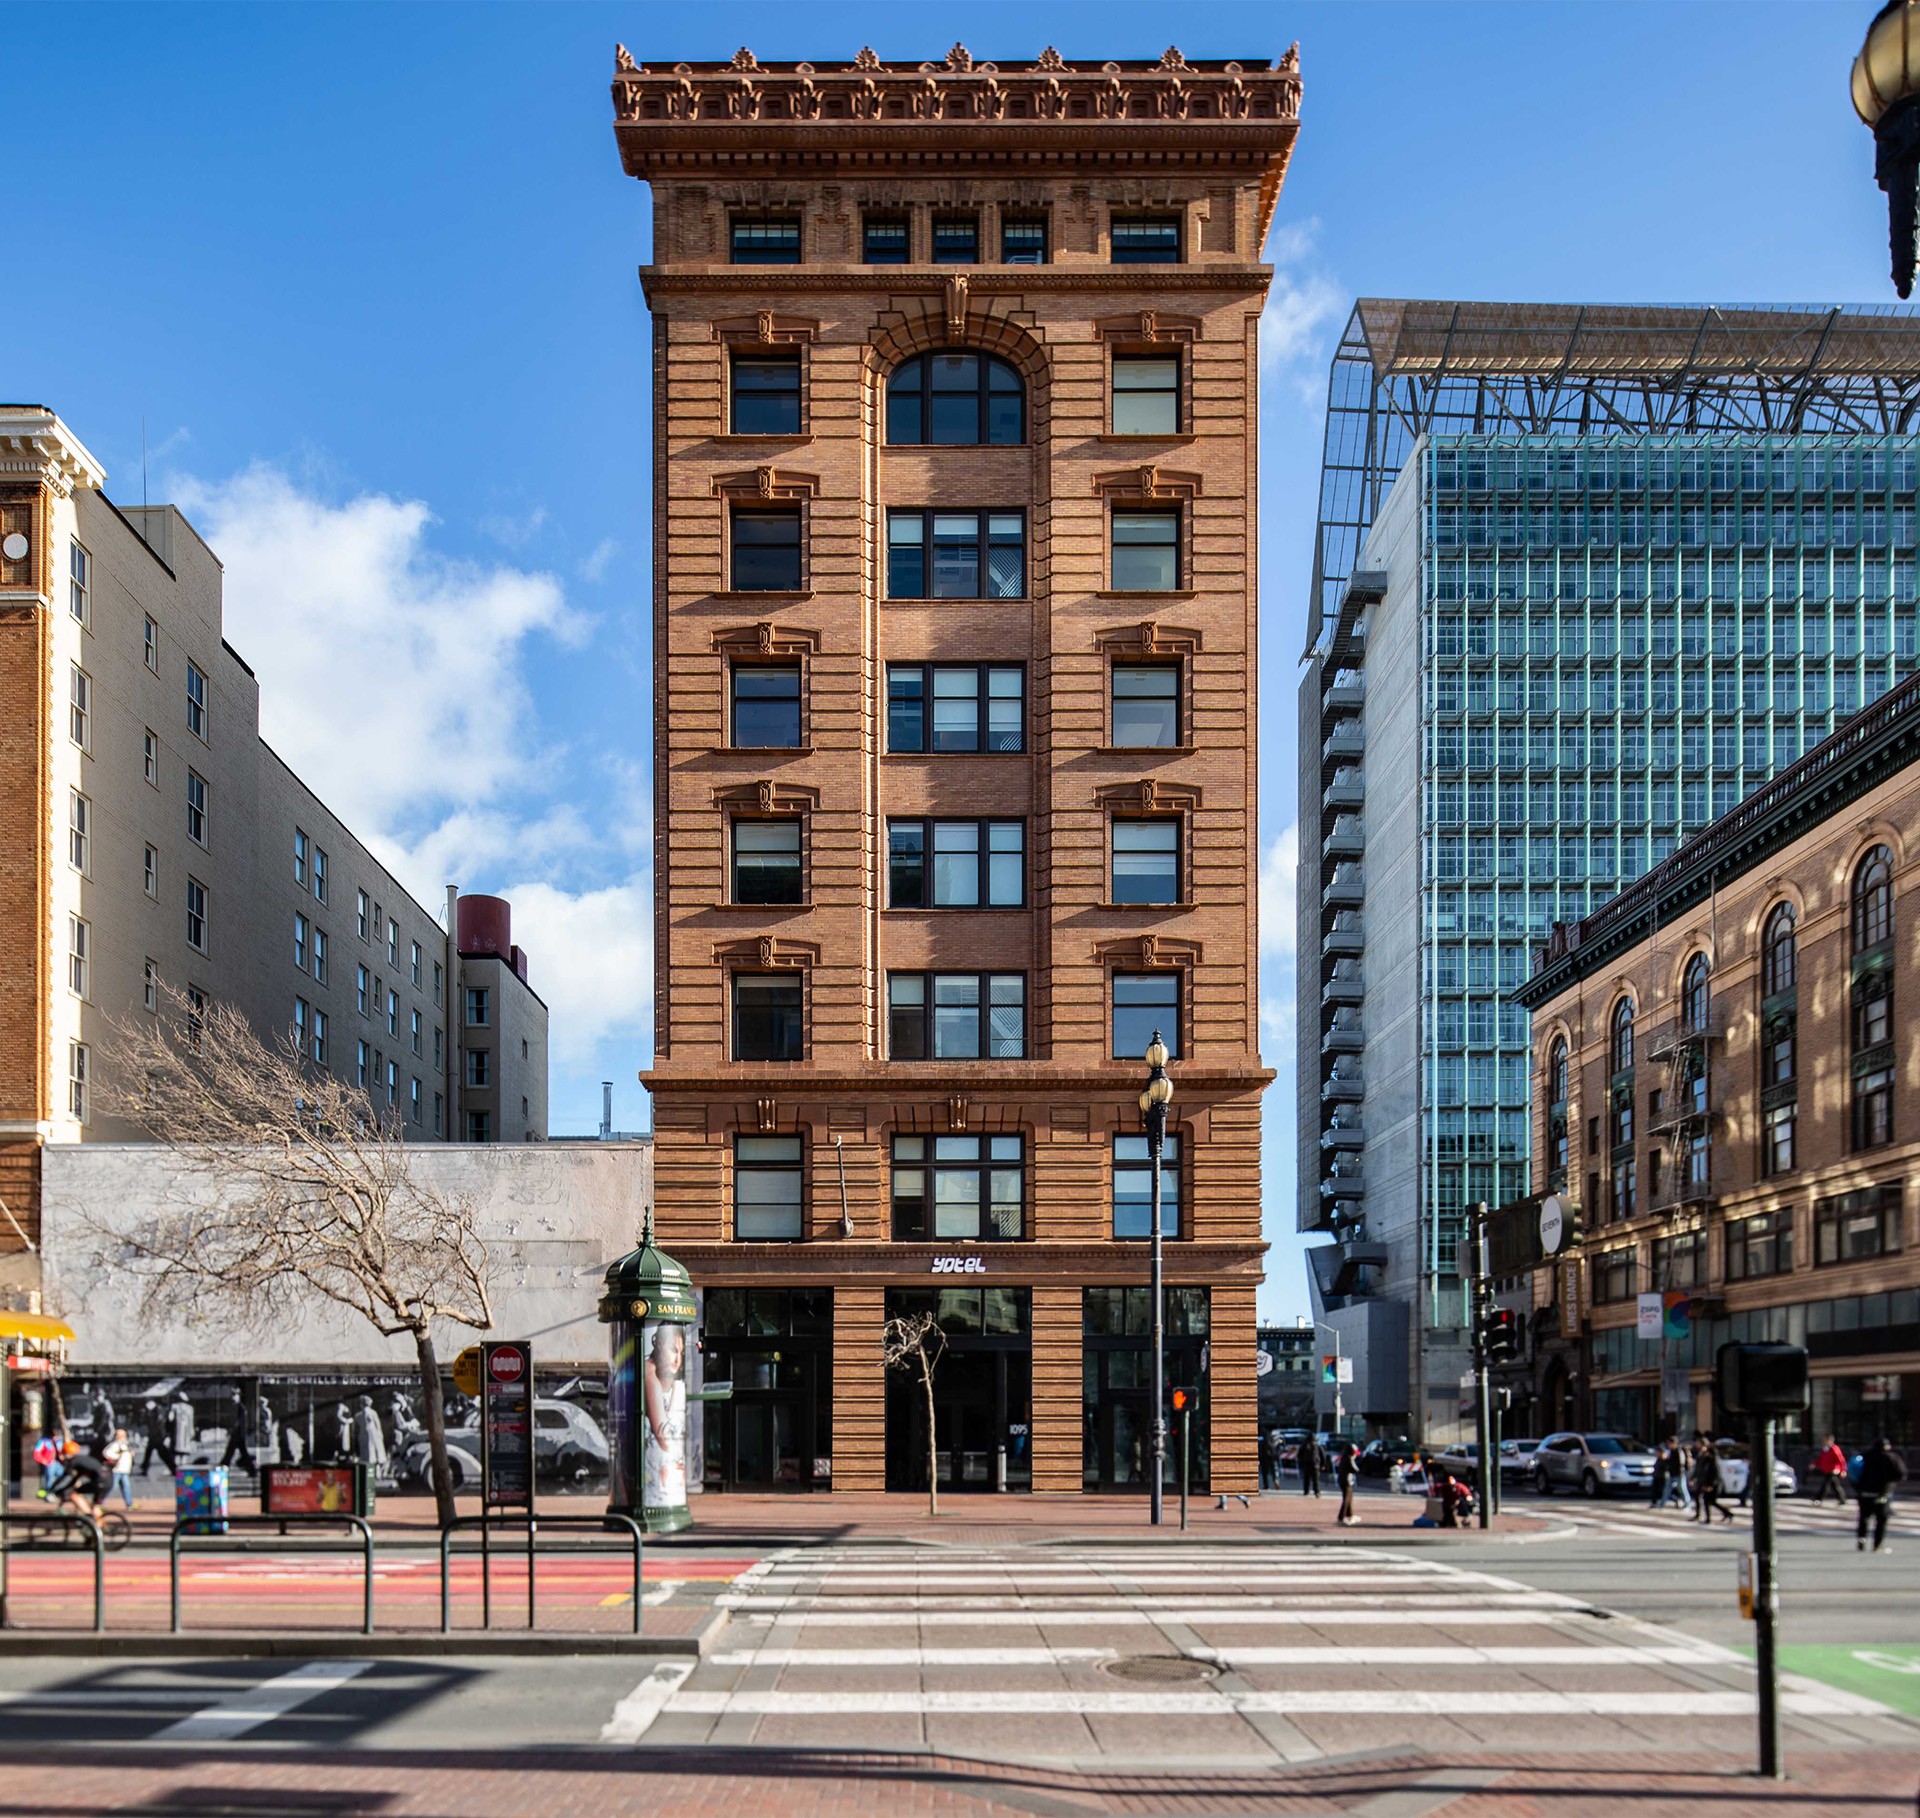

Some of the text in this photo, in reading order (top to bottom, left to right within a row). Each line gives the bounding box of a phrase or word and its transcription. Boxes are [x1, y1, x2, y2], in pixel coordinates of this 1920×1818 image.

[1566, 1265, 1578, 1300] DANCE
[658, 1304, 673, 1314] SAN
[1566, 1302, 1578, 1332] LINES
[342, 1376, 368, 1385] DRUG
[373, 1376, 412, 1385] CENTER
[1009, 1424, 1028, 1435] 1095
